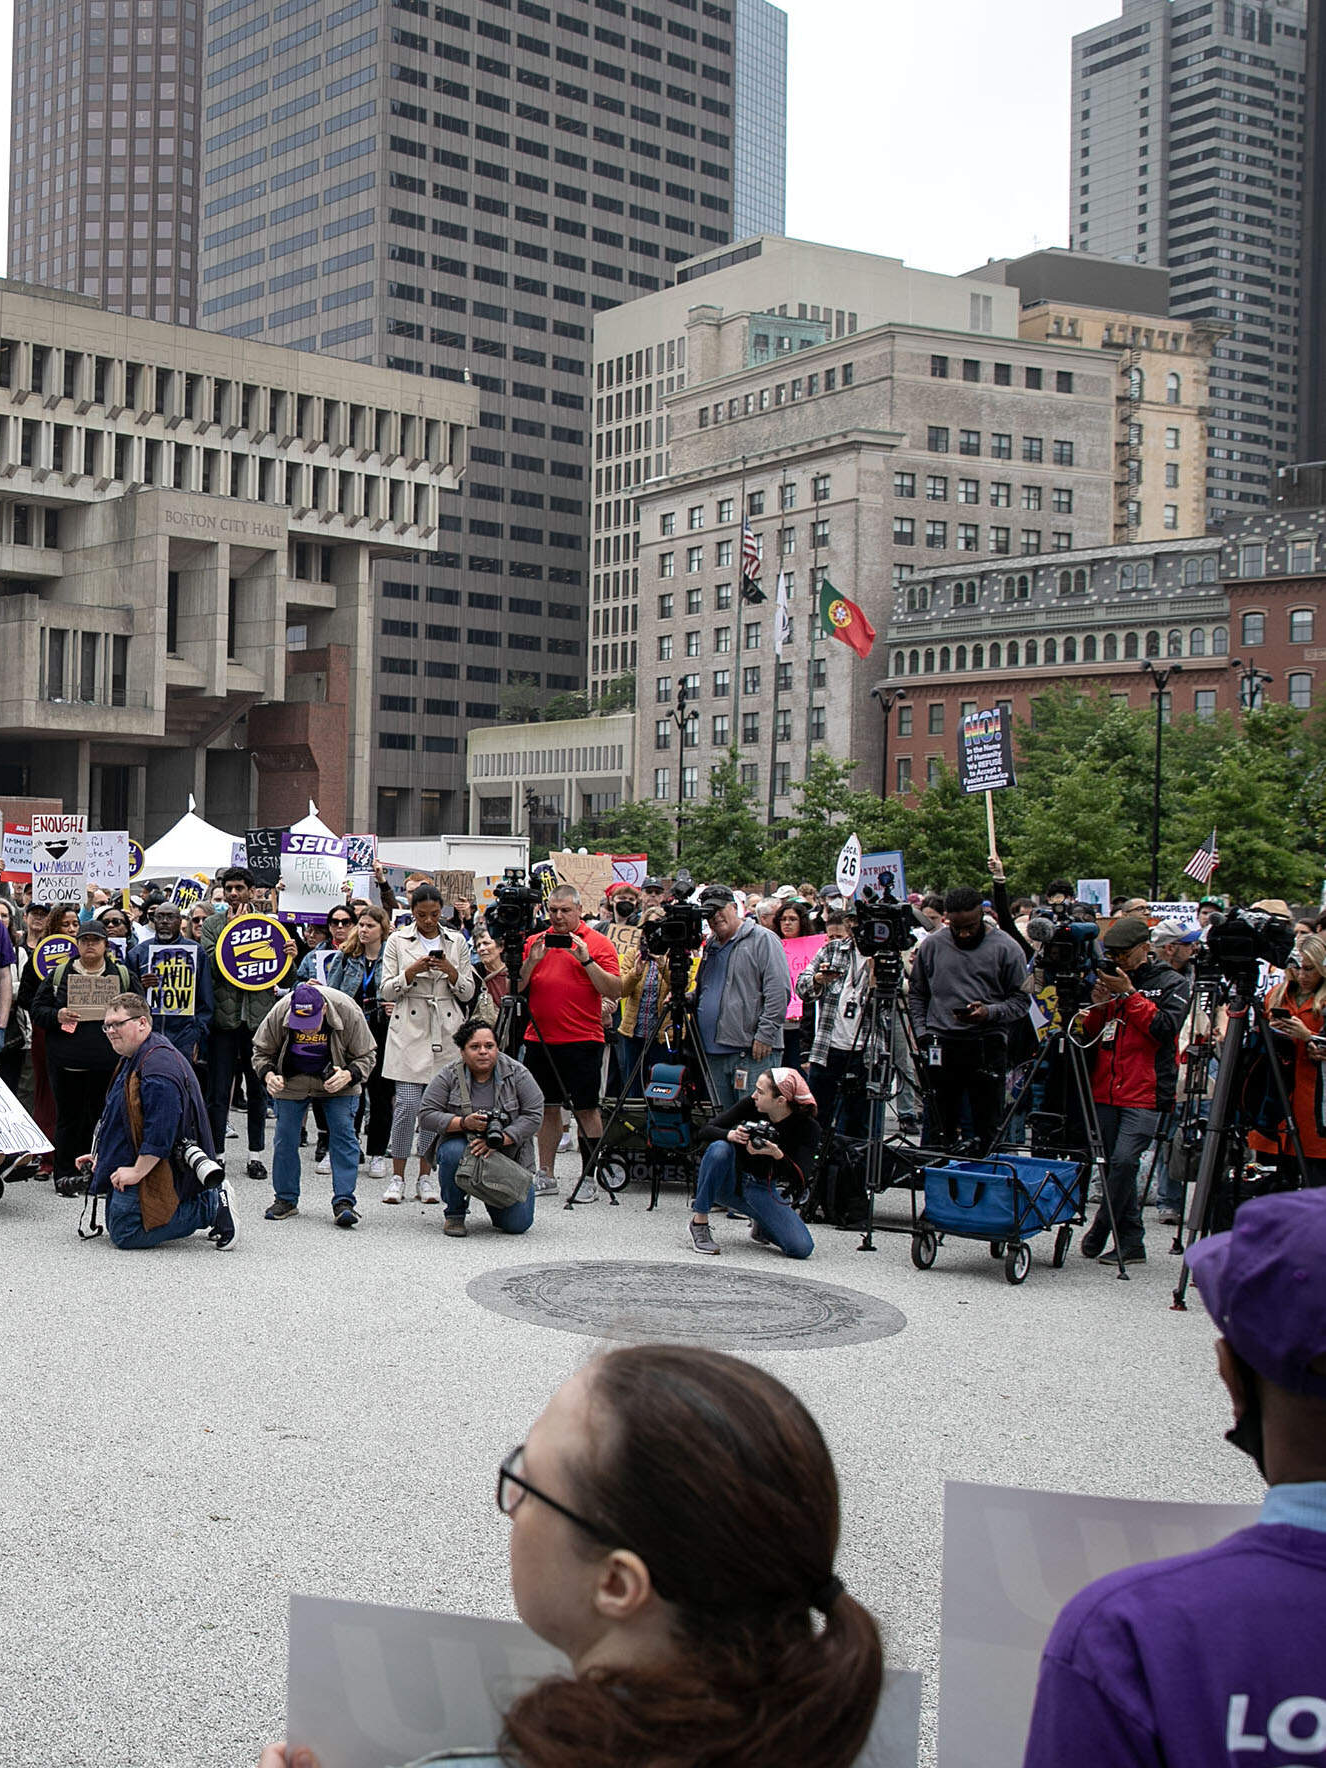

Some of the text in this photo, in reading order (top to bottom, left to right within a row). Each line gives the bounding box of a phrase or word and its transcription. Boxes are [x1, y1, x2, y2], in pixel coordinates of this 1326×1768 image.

[165, 510, 283, 538] BOSTON CITY HALL
[964, 708, 1003, 747] NO!
[34, 816, 84, 833] ENOUGH!
[247, 832, 277, 847] ICE
[287, 835, 344, 855] SEIU
[88, 849, 115, 858] otest
[249, 855, 281, 869] GESTA
[295, 857, 325, 871] FREE
[842, 856, 857, 877] 26
[87, 866, 121, 878] otic!
[299, 871, 332, 882] THEM
[37, 877, 78, 888] MASKED
[301, 883, 339, 896] NOW!!!
[38, 888, 82, 901] GOONS
[230, 925, 272, 945] 32BJ
[610, 927, 640, 947] ICE
[42, 942, 72, 955] 32BJ
[152, 951, 194, 966] FREE
[153, 965, 193, 988] DAVID
[238, 959, 278, 979] SEIU
[151, 987, 192, 1009] NOW
